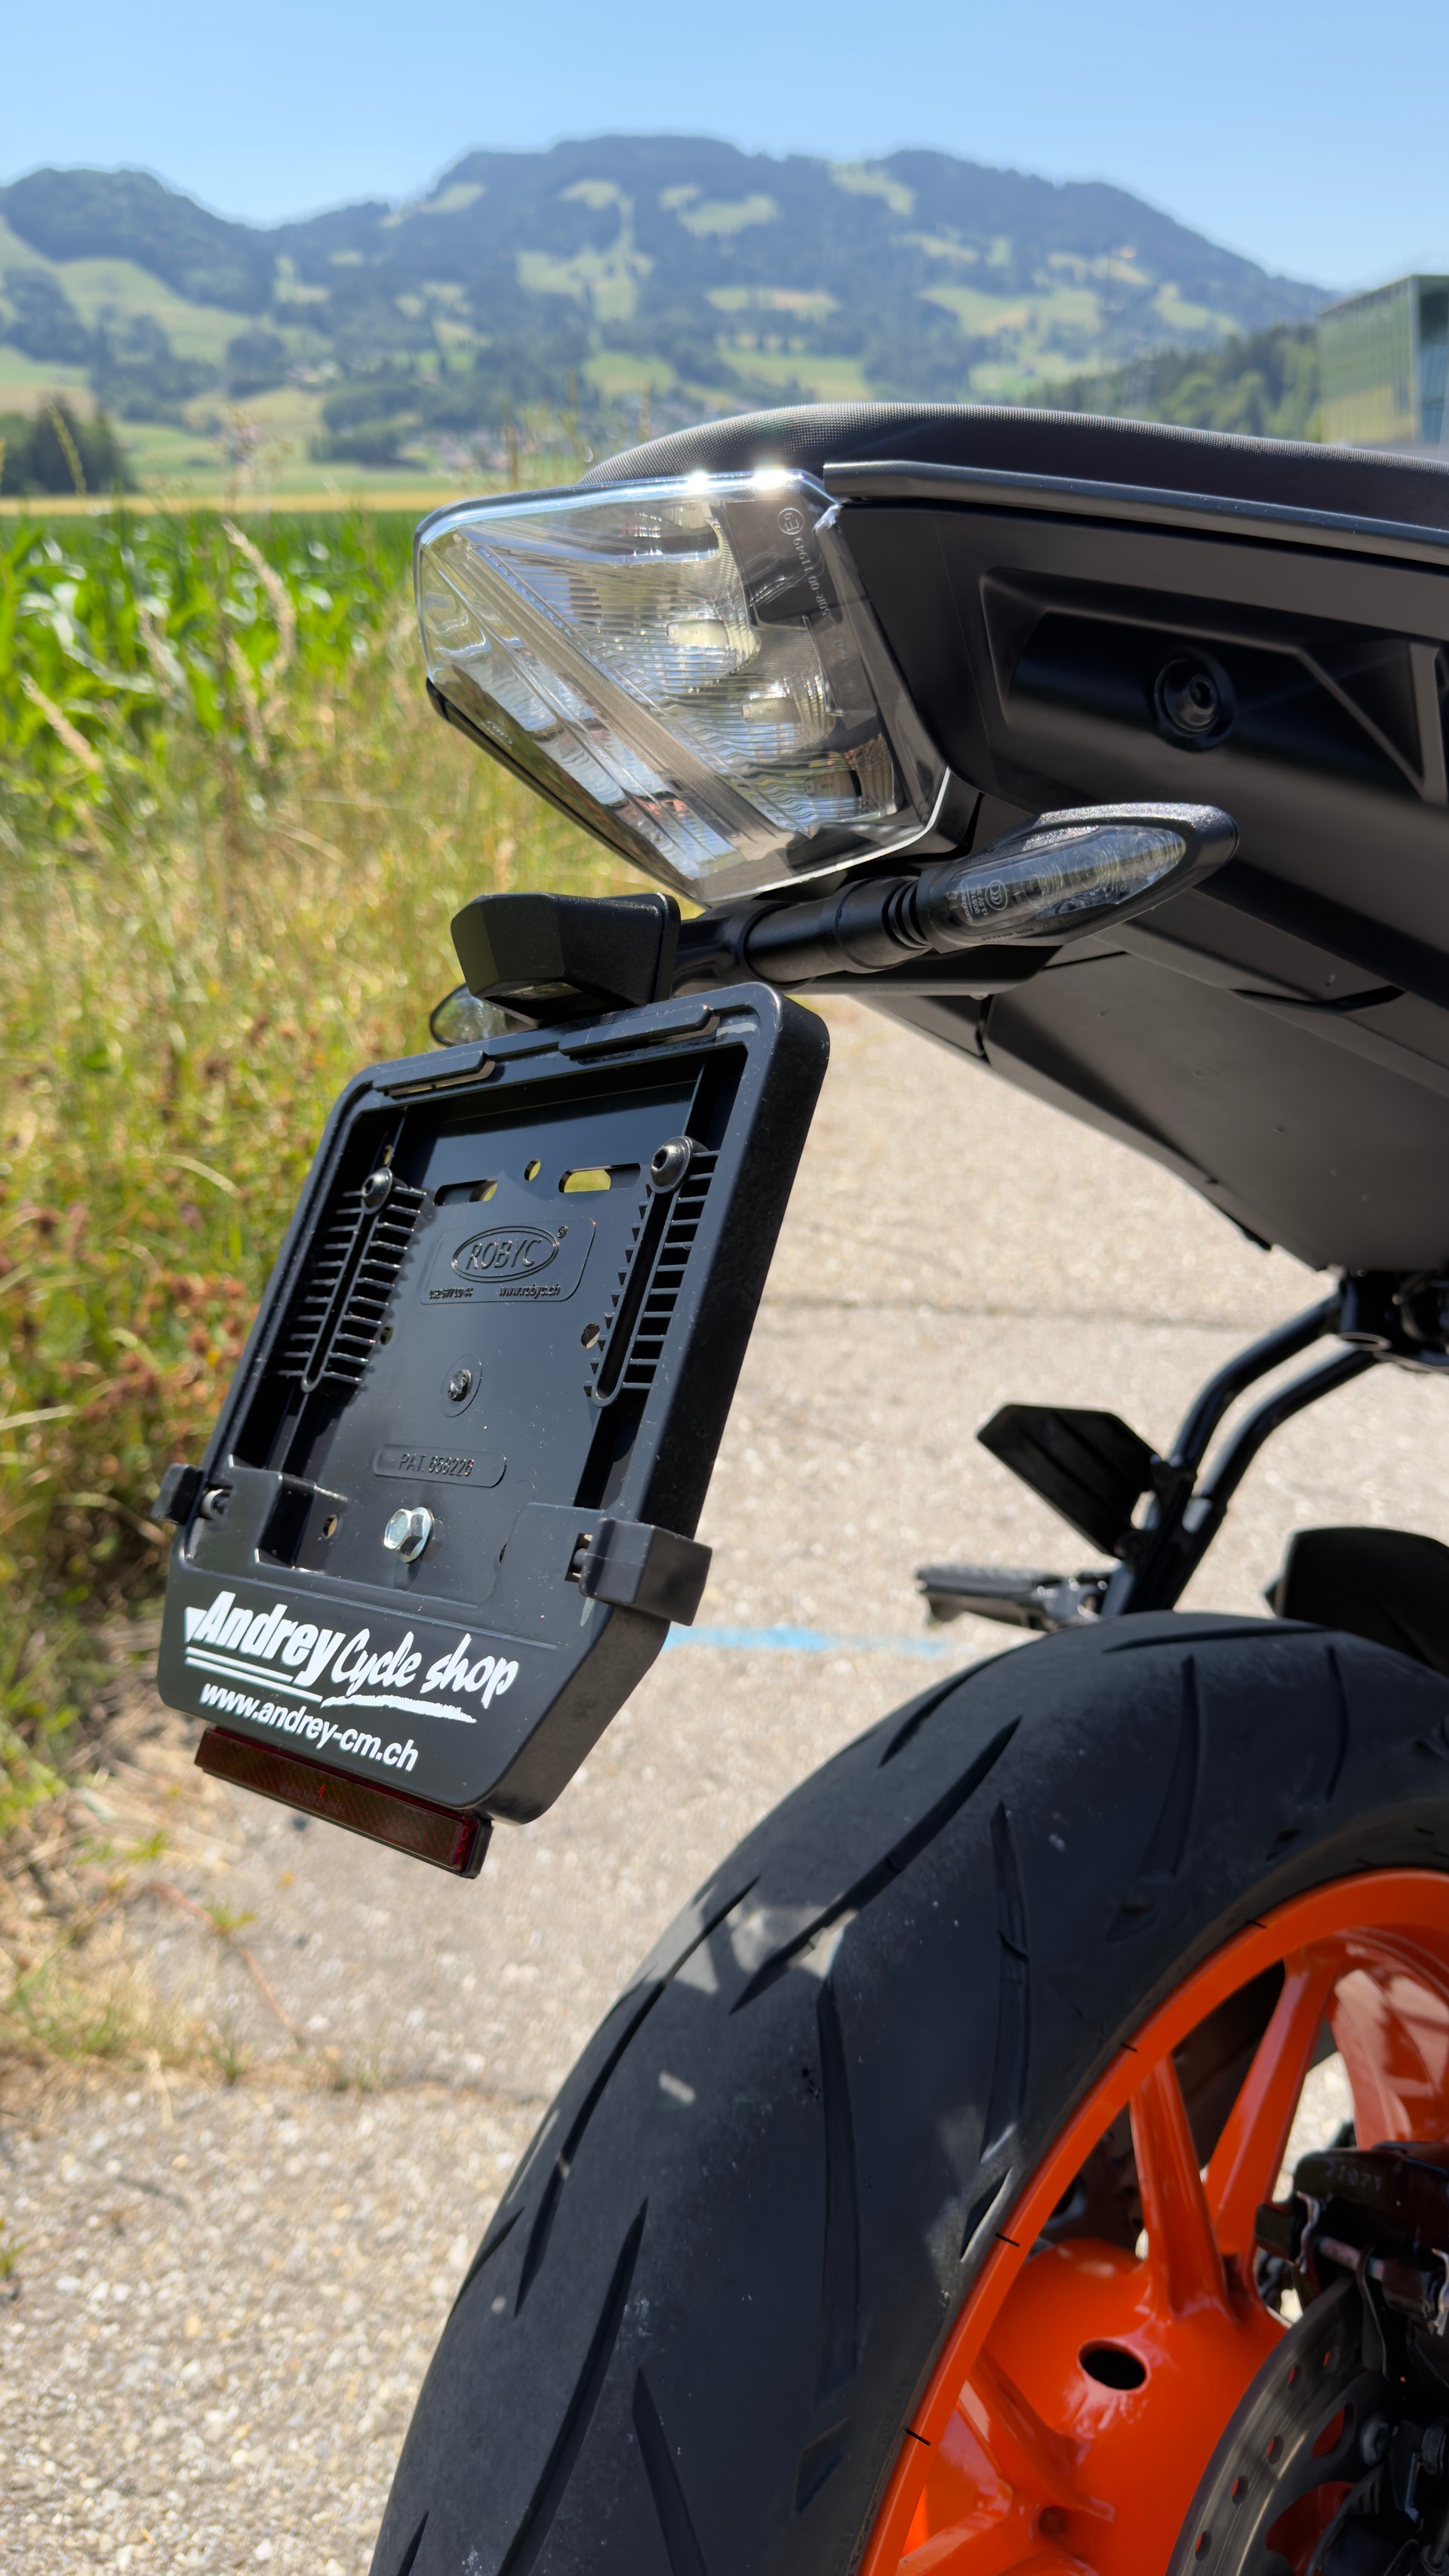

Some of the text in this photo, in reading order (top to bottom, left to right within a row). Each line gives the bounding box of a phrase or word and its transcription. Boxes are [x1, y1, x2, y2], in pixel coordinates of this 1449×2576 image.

[465, 1239, 543, 1270] ROBYC
[186, 1590, 519, 1710] Andrey Cycle shop
[198, 1683, 419, 1773] www.andrey-cm.ch
